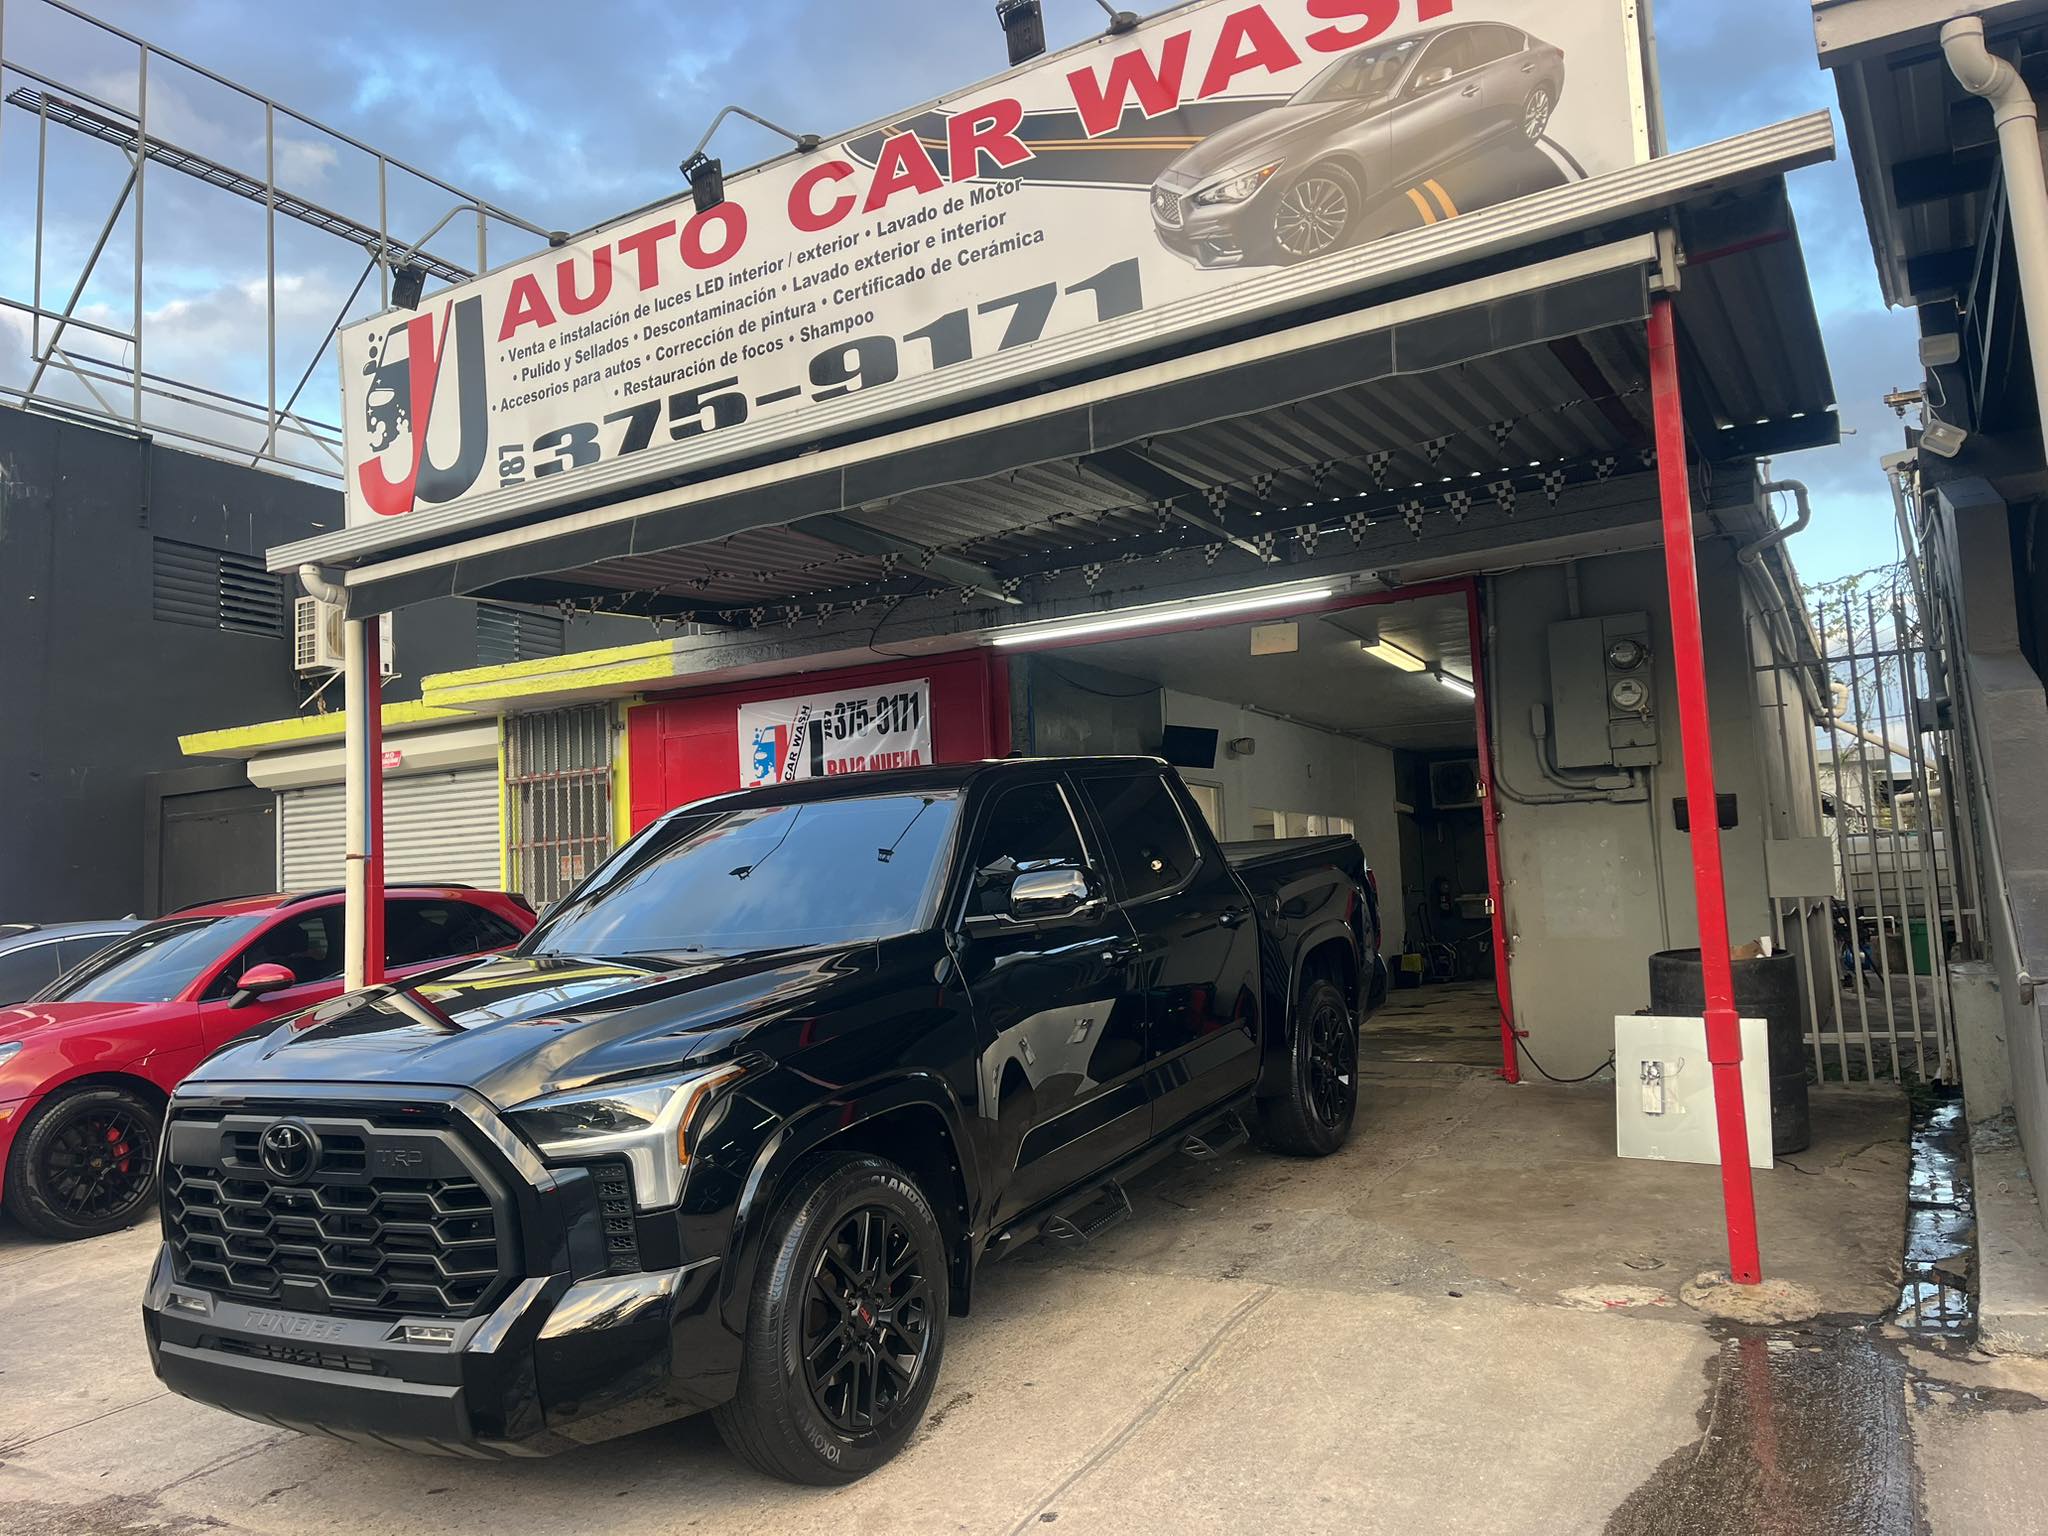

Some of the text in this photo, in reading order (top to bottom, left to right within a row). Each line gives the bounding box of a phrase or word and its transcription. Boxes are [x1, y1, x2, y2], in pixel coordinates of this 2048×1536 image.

[497, 0, 1453, 342] AUTO CAR WAS
[500, 229, 1045, 412] Accesorios para autos Corrección de pintura Certificado de Cerámica
[508, 341, 545, 362] Venta
[549, 338, 556, 349] e
[560, 311, 630, 345] instalación
[634, 304, 650, 319] de
[654, 290, 692, 312] luces
[696, 276, 724, 298] LED
[729, 257, 784, 287] interior
[797, 233, 859, 264] exterior
[877, 206, 937, 237] Lavado
[943, 198, 964, 214] de
[970, 177, 1022, 207] Motor
[521, 211, 1006, 382] Pulido y Sellados Descontaminación Lavado exterior e interior
[623, 310, 874, 398] Restauración de focos Shampoo
[533, 257, 1143, 479] 375-9171
[785, 705, 810, 781] CAR WASH
[824, 691, 919, 740] 787 375-9171
[376, 1149, 423, 1167] TRD
